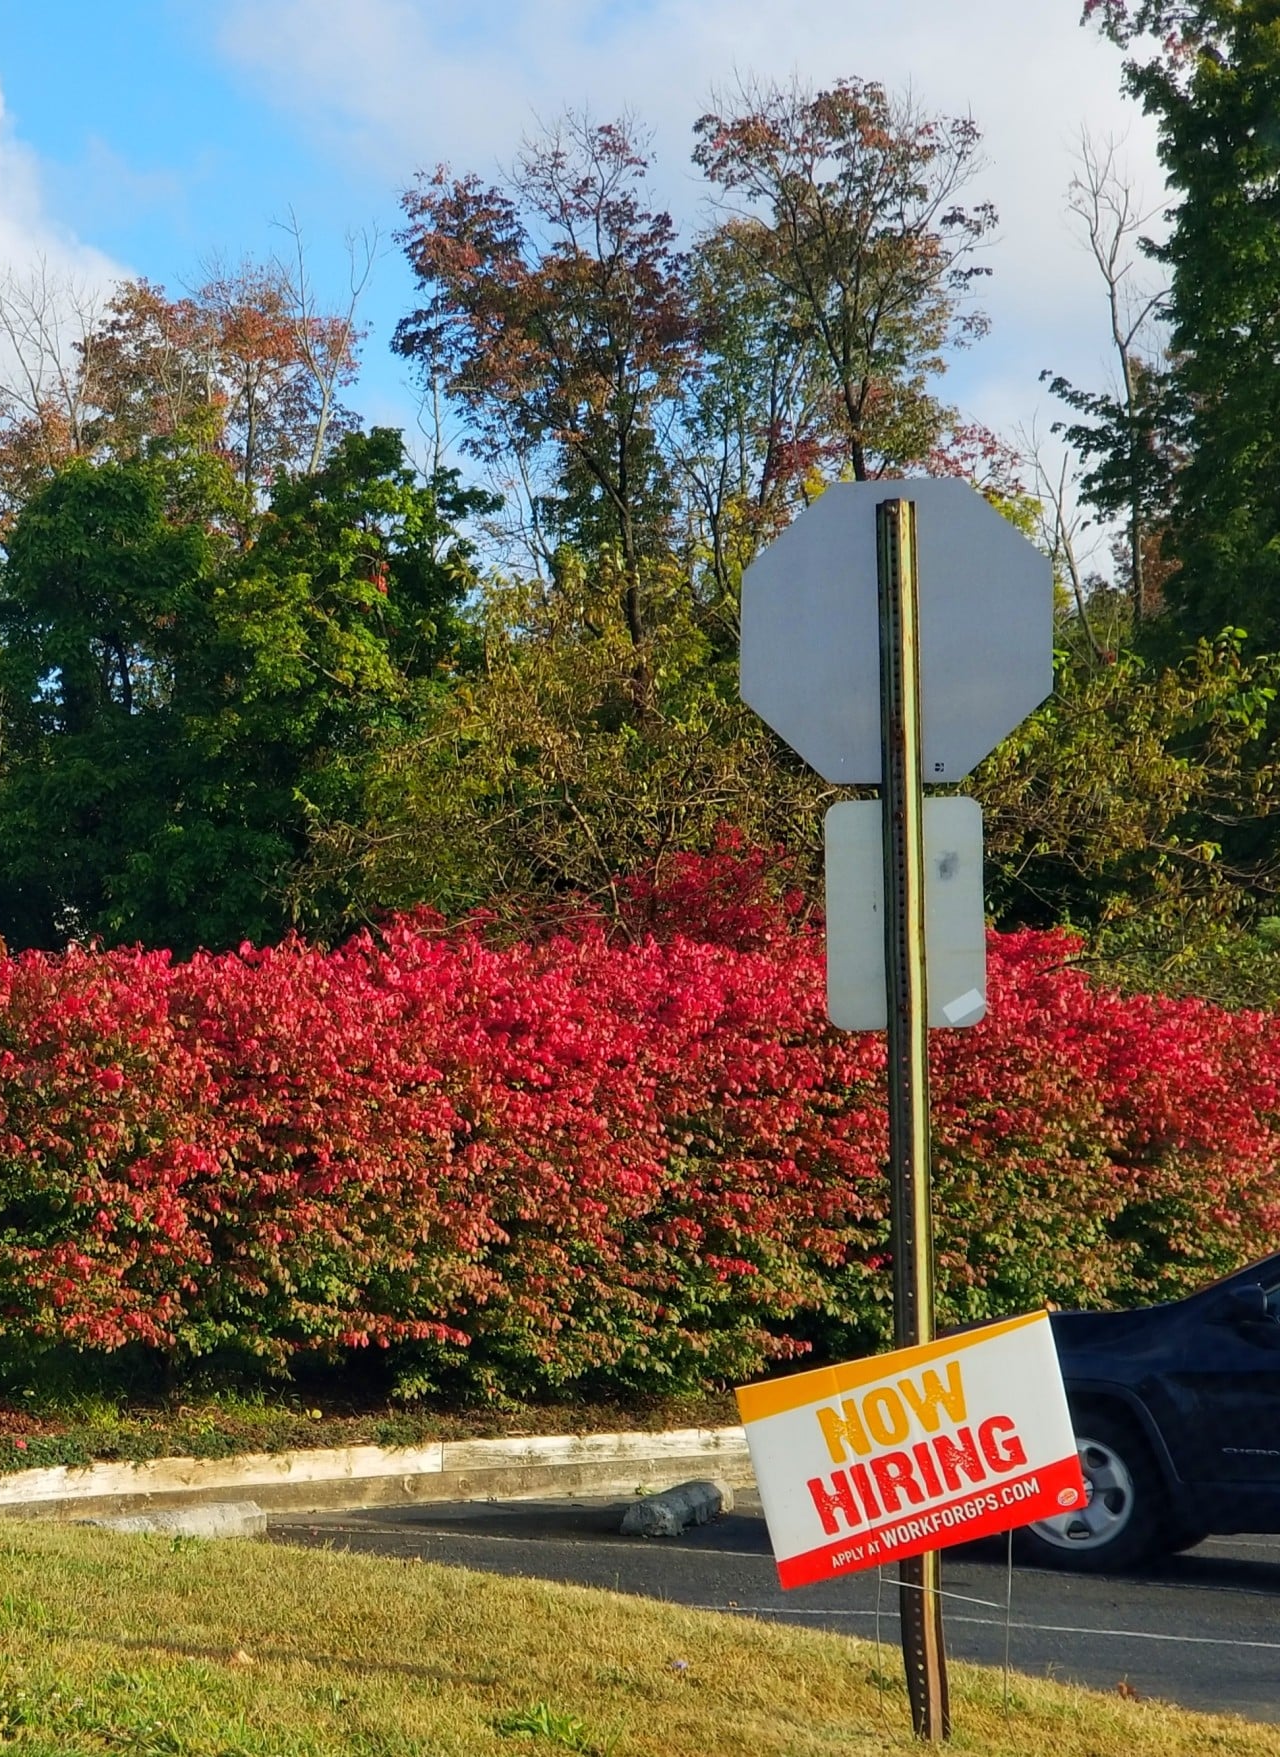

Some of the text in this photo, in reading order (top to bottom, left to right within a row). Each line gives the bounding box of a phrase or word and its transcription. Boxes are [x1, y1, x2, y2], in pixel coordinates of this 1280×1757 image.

[815, 1360, 968, 1463] NOW
[806, 1415, 1027, 1536] HIRING
[831, 1547, 864, 1568] APPLY
[867, 1540, 881, 1556] AT
[879, 1477, 1041, 1549] WORKFORGPS.COM
